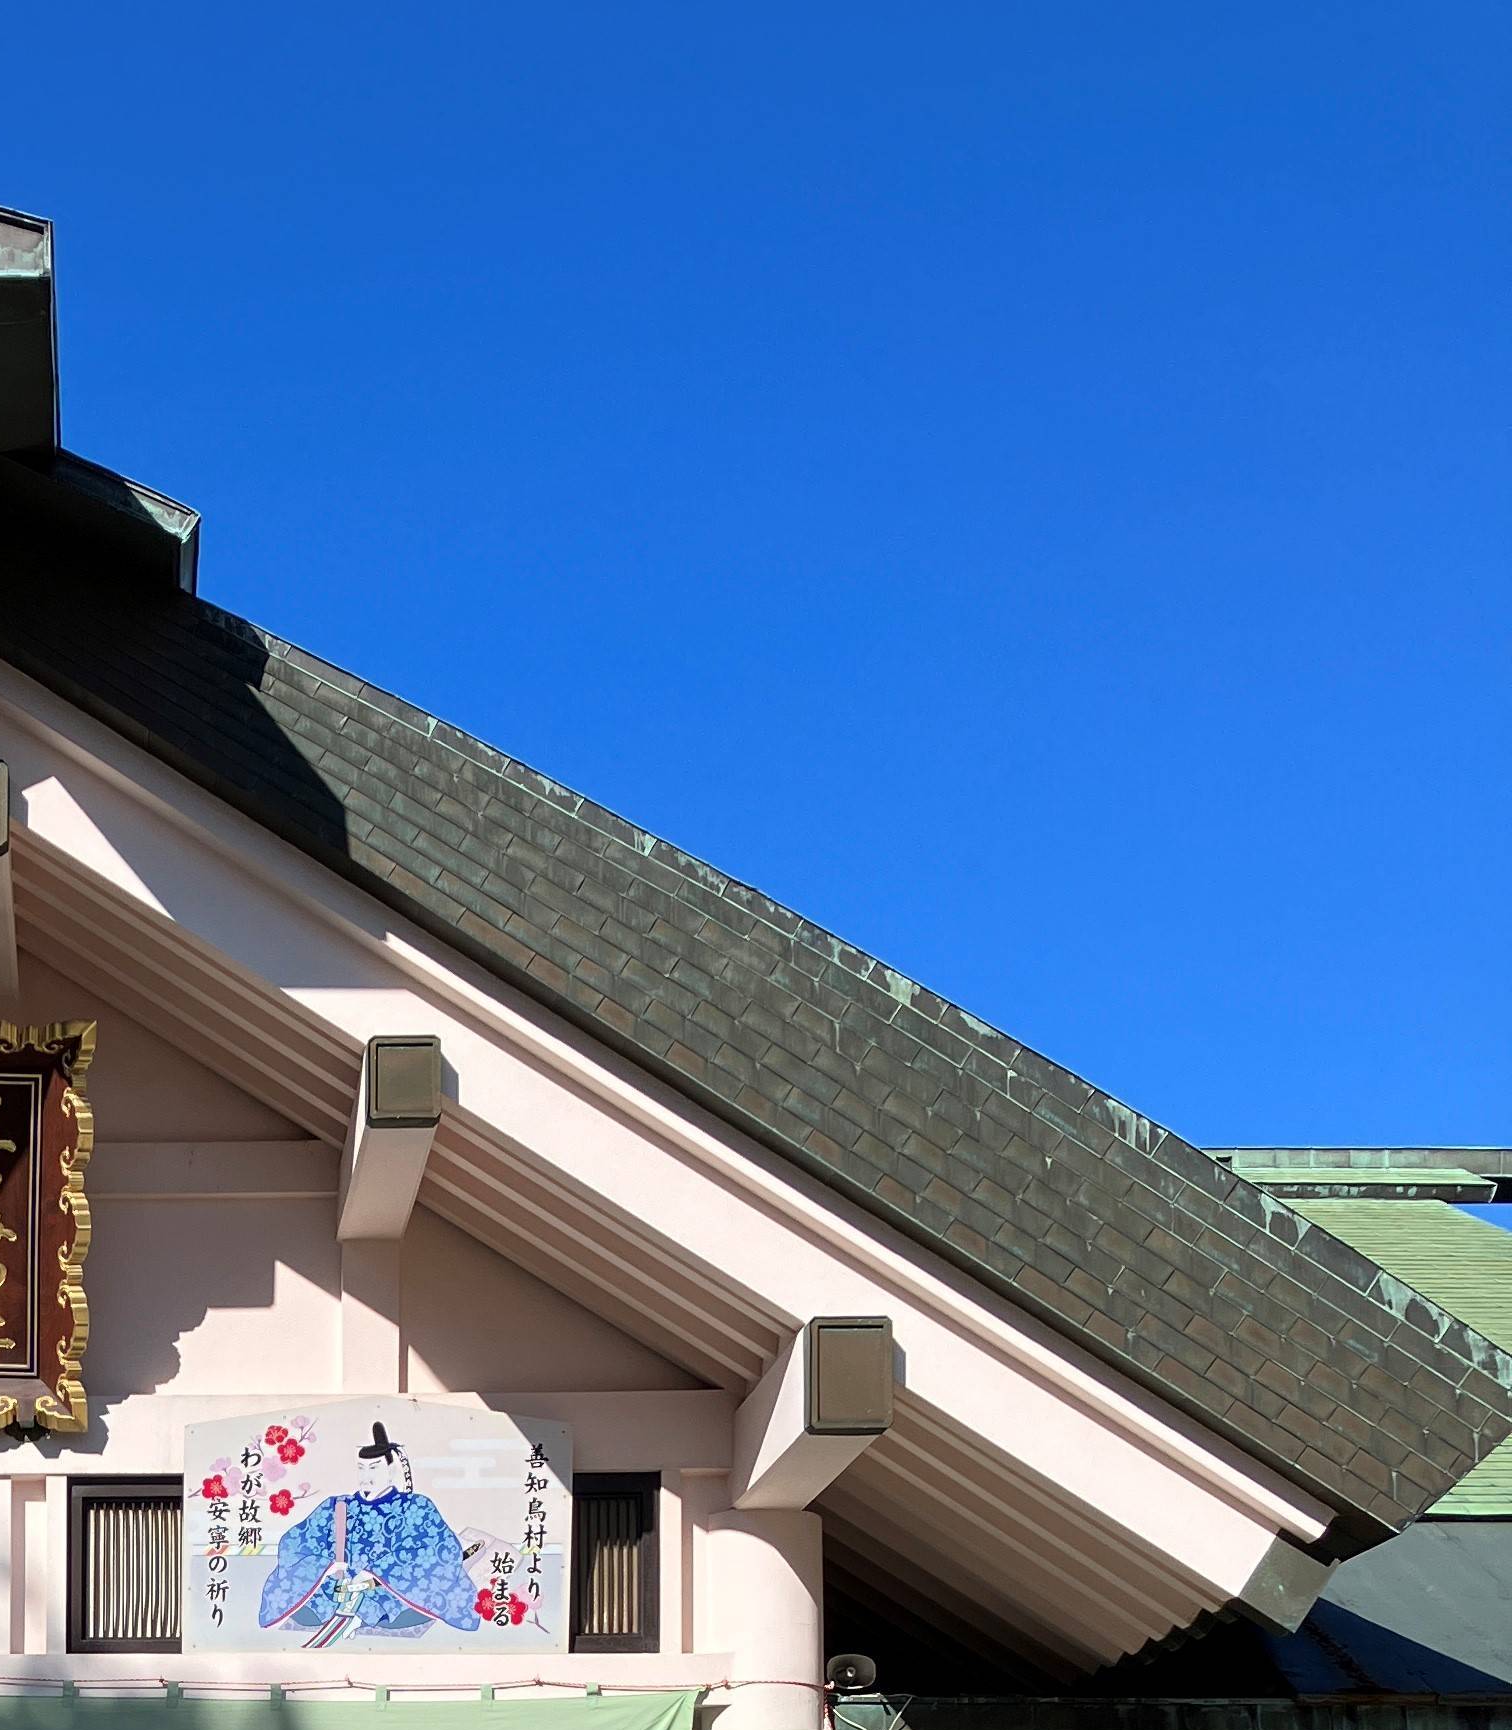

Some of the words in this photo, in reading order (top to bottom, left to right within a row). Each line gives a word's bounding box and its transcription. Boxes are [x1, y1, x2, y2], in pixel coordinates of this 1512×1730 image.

[237, 1446, 263, 1550] わが故郷
[522, 1443, 549, 1602] 善知鳥村より
[206, 1498, 231, 1629] 安寧の祈り
[489, 1551, 515, 1627] 始まる
